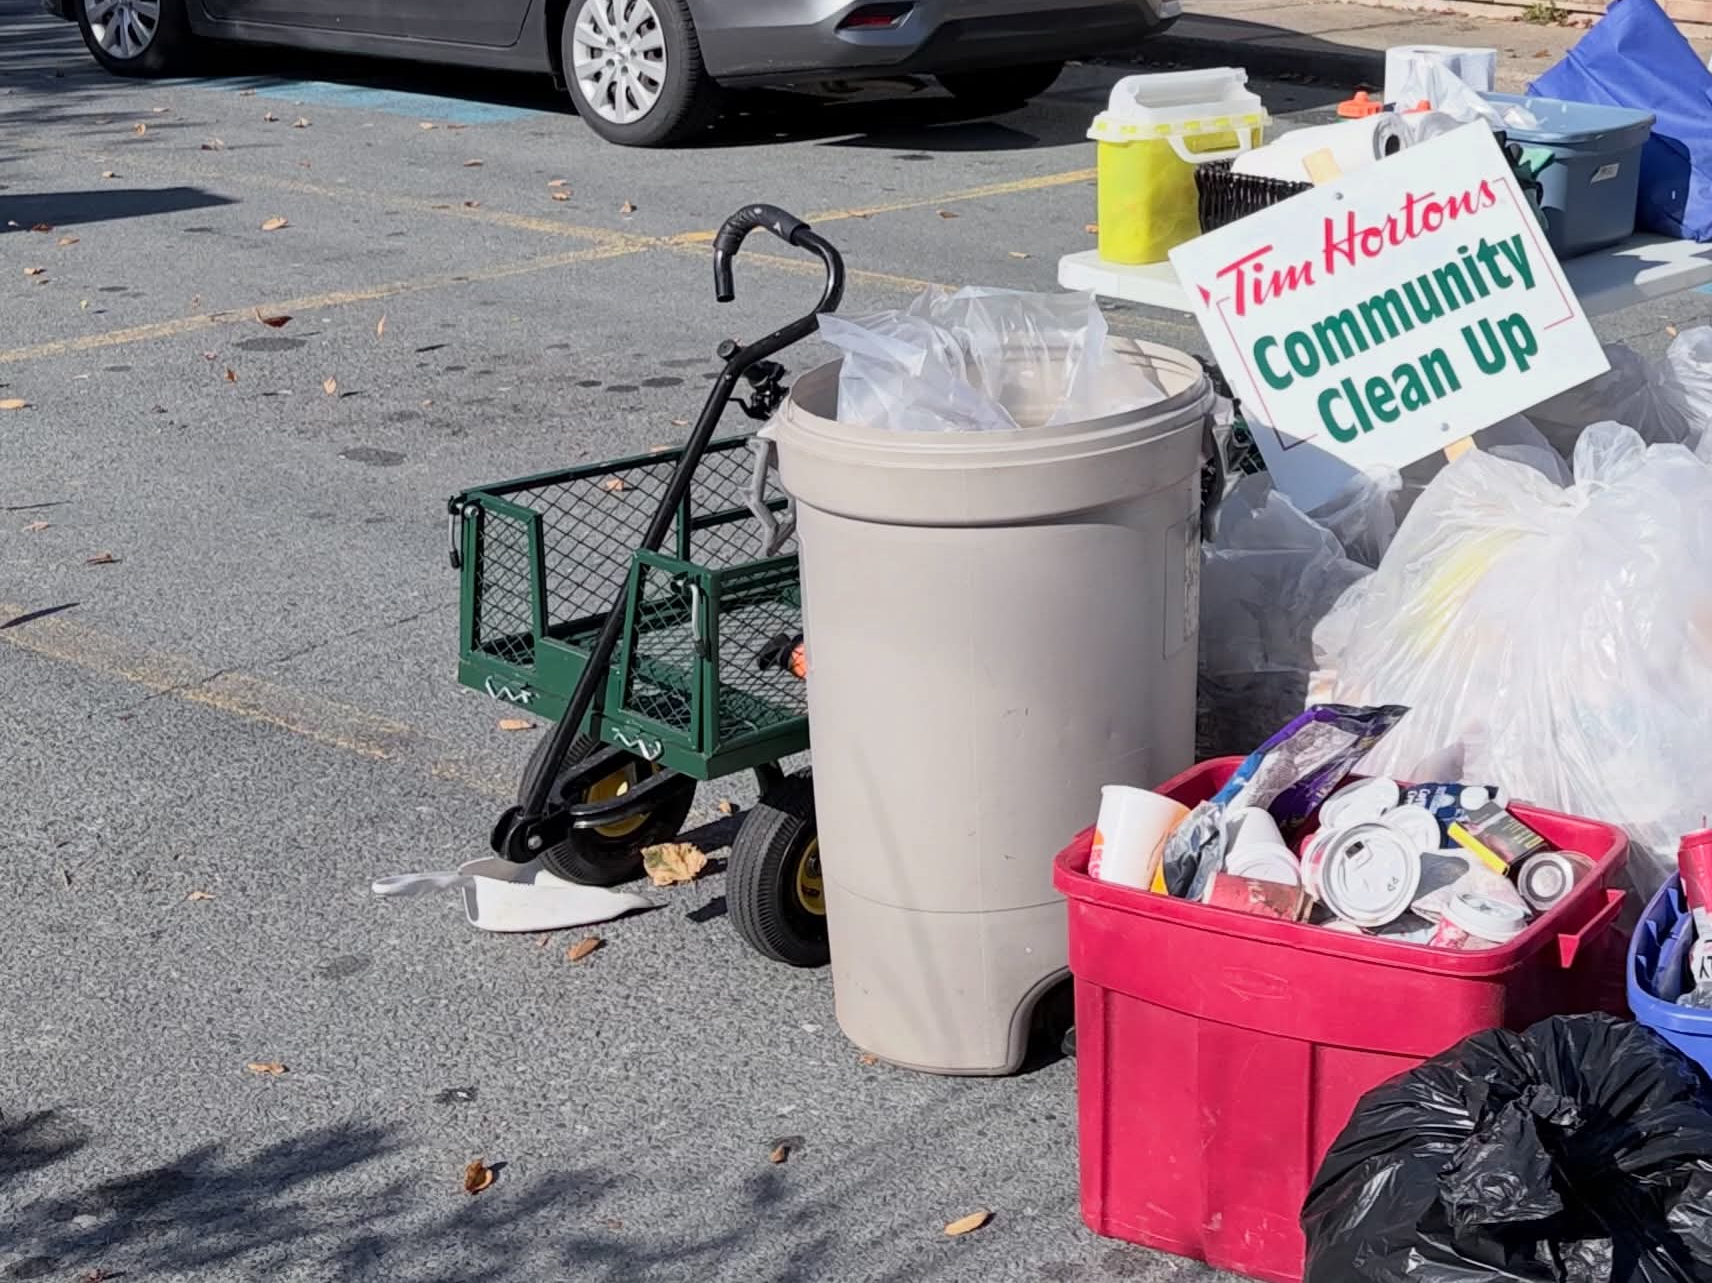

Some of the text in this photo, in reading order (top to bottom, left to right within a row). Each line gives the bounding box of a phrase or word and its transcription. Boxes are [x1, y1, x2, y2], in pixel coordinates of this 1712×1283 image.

[1215, 179, 1497, 317] Tim Hortons
[1252, 233, 1537, 392] Community
[1316, 311, 1539, 444] Clean Up
